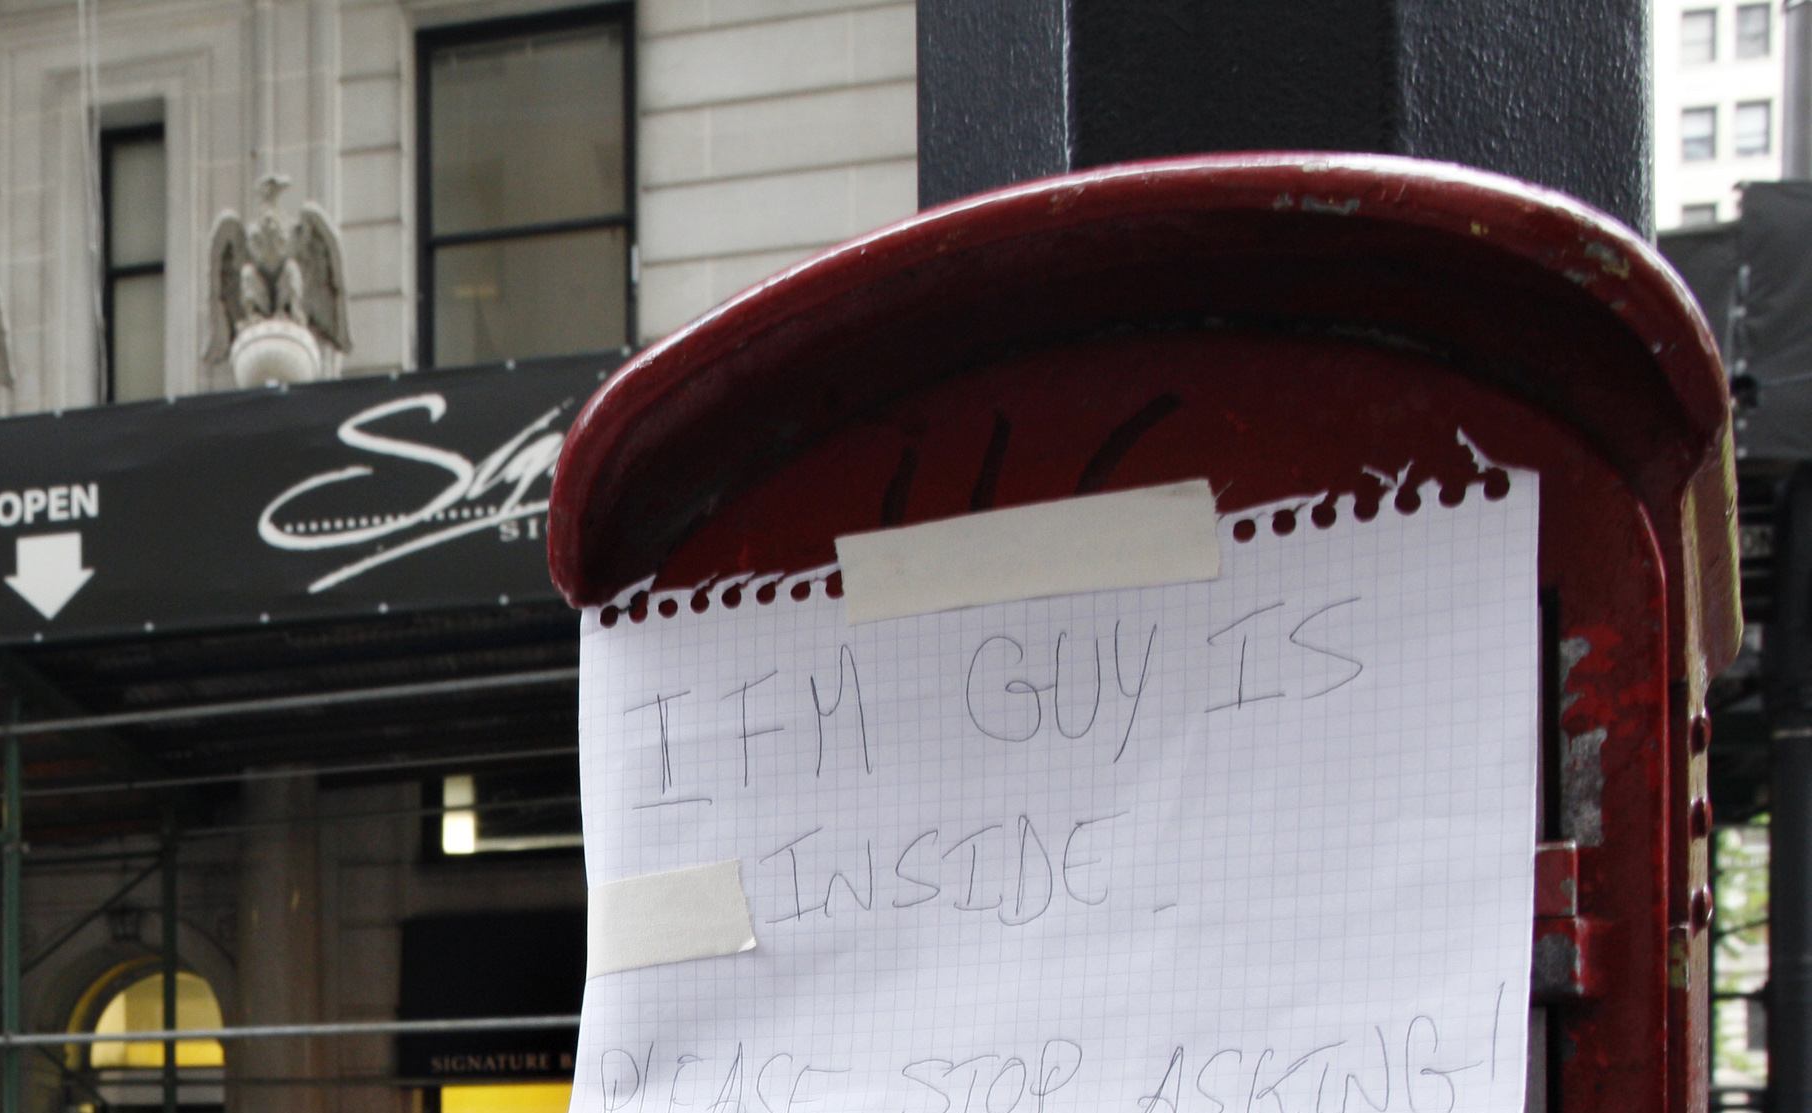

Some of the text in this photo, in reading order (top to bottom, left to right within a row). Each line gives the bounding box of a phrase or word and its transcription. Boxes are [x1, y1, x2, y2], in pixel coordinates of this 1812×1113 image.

[966, 619, 1158, 763] GUY
[1204, 596, 1364, 714] IS
[431, 1053, 550, 1073] SIGNATURE
